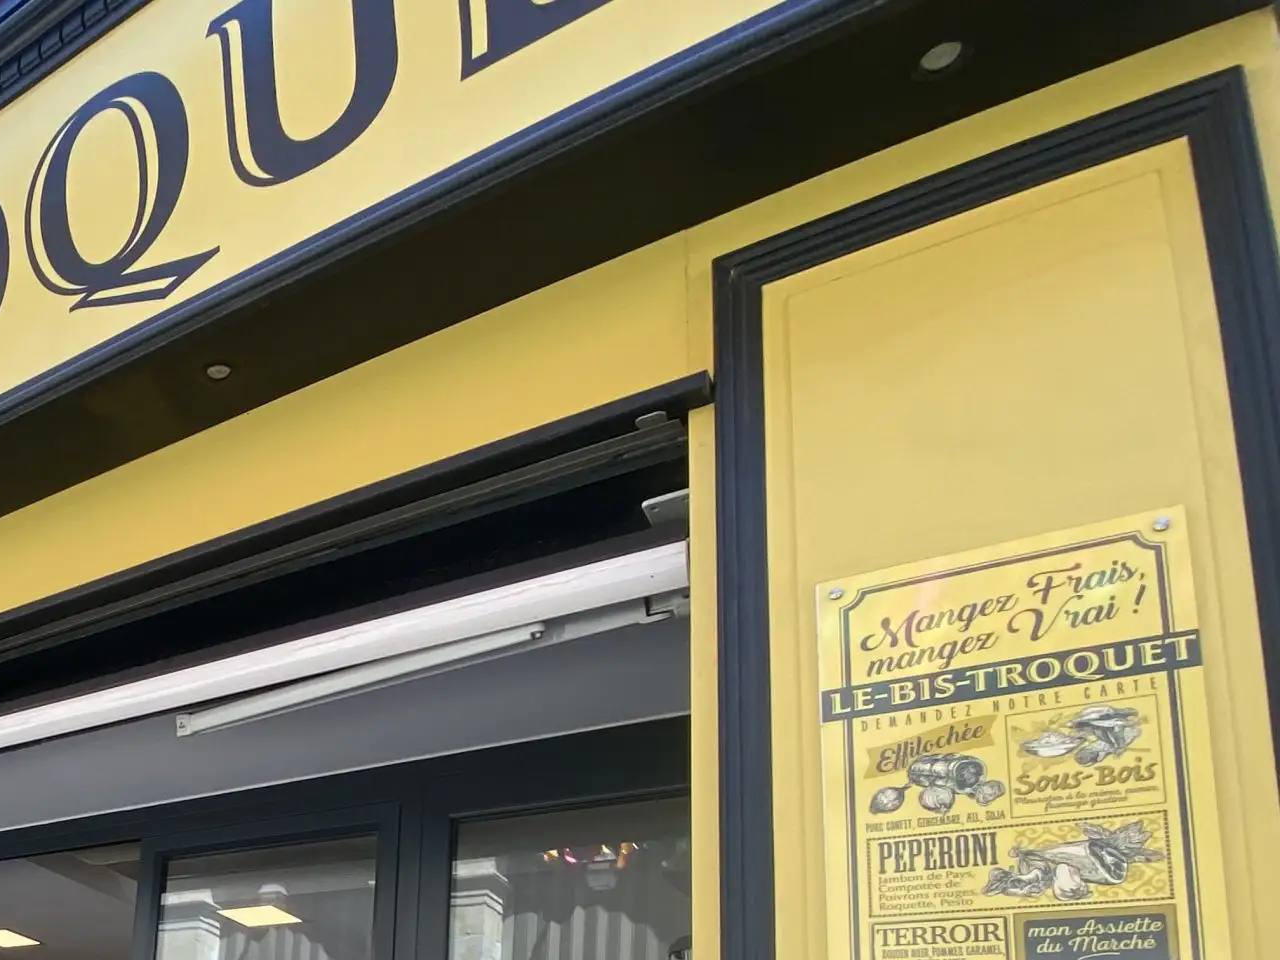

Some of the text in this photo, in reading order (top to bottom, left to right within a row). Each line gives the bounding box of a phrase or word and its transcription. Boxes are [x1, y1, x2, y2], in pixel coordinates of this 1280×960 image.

[861, 562, 1146, 652] Mangez Frais,
[866, 584, 1146, 677] mangez Vrai !
[829, 634, 1197, 714] LE-BIS-TROQUET
[861, 677, 1158, 732] DEMANDEZ NOTRE CARTE
[876, 723, 984, 773] Effilochée
[1014, 756, 1158, 795] Sous-Bois
[985, 810, 1006, 820] SOJA
[878, 832, 999, 874] PEPERONI
[879, 874, 924, 885] Jambon
[945, 871, 975, 880] Pays,
[879, 879, 962, 893] Compotée de
[879, 891, 929, 901] Poivrons
[940, 898, 974, 907] Pesto
[876, 923, 1004, 947] TERROIR
[1028, 917, 1165, 937] mon Assiette
[1037, 934, 1157, 953] du Marché
